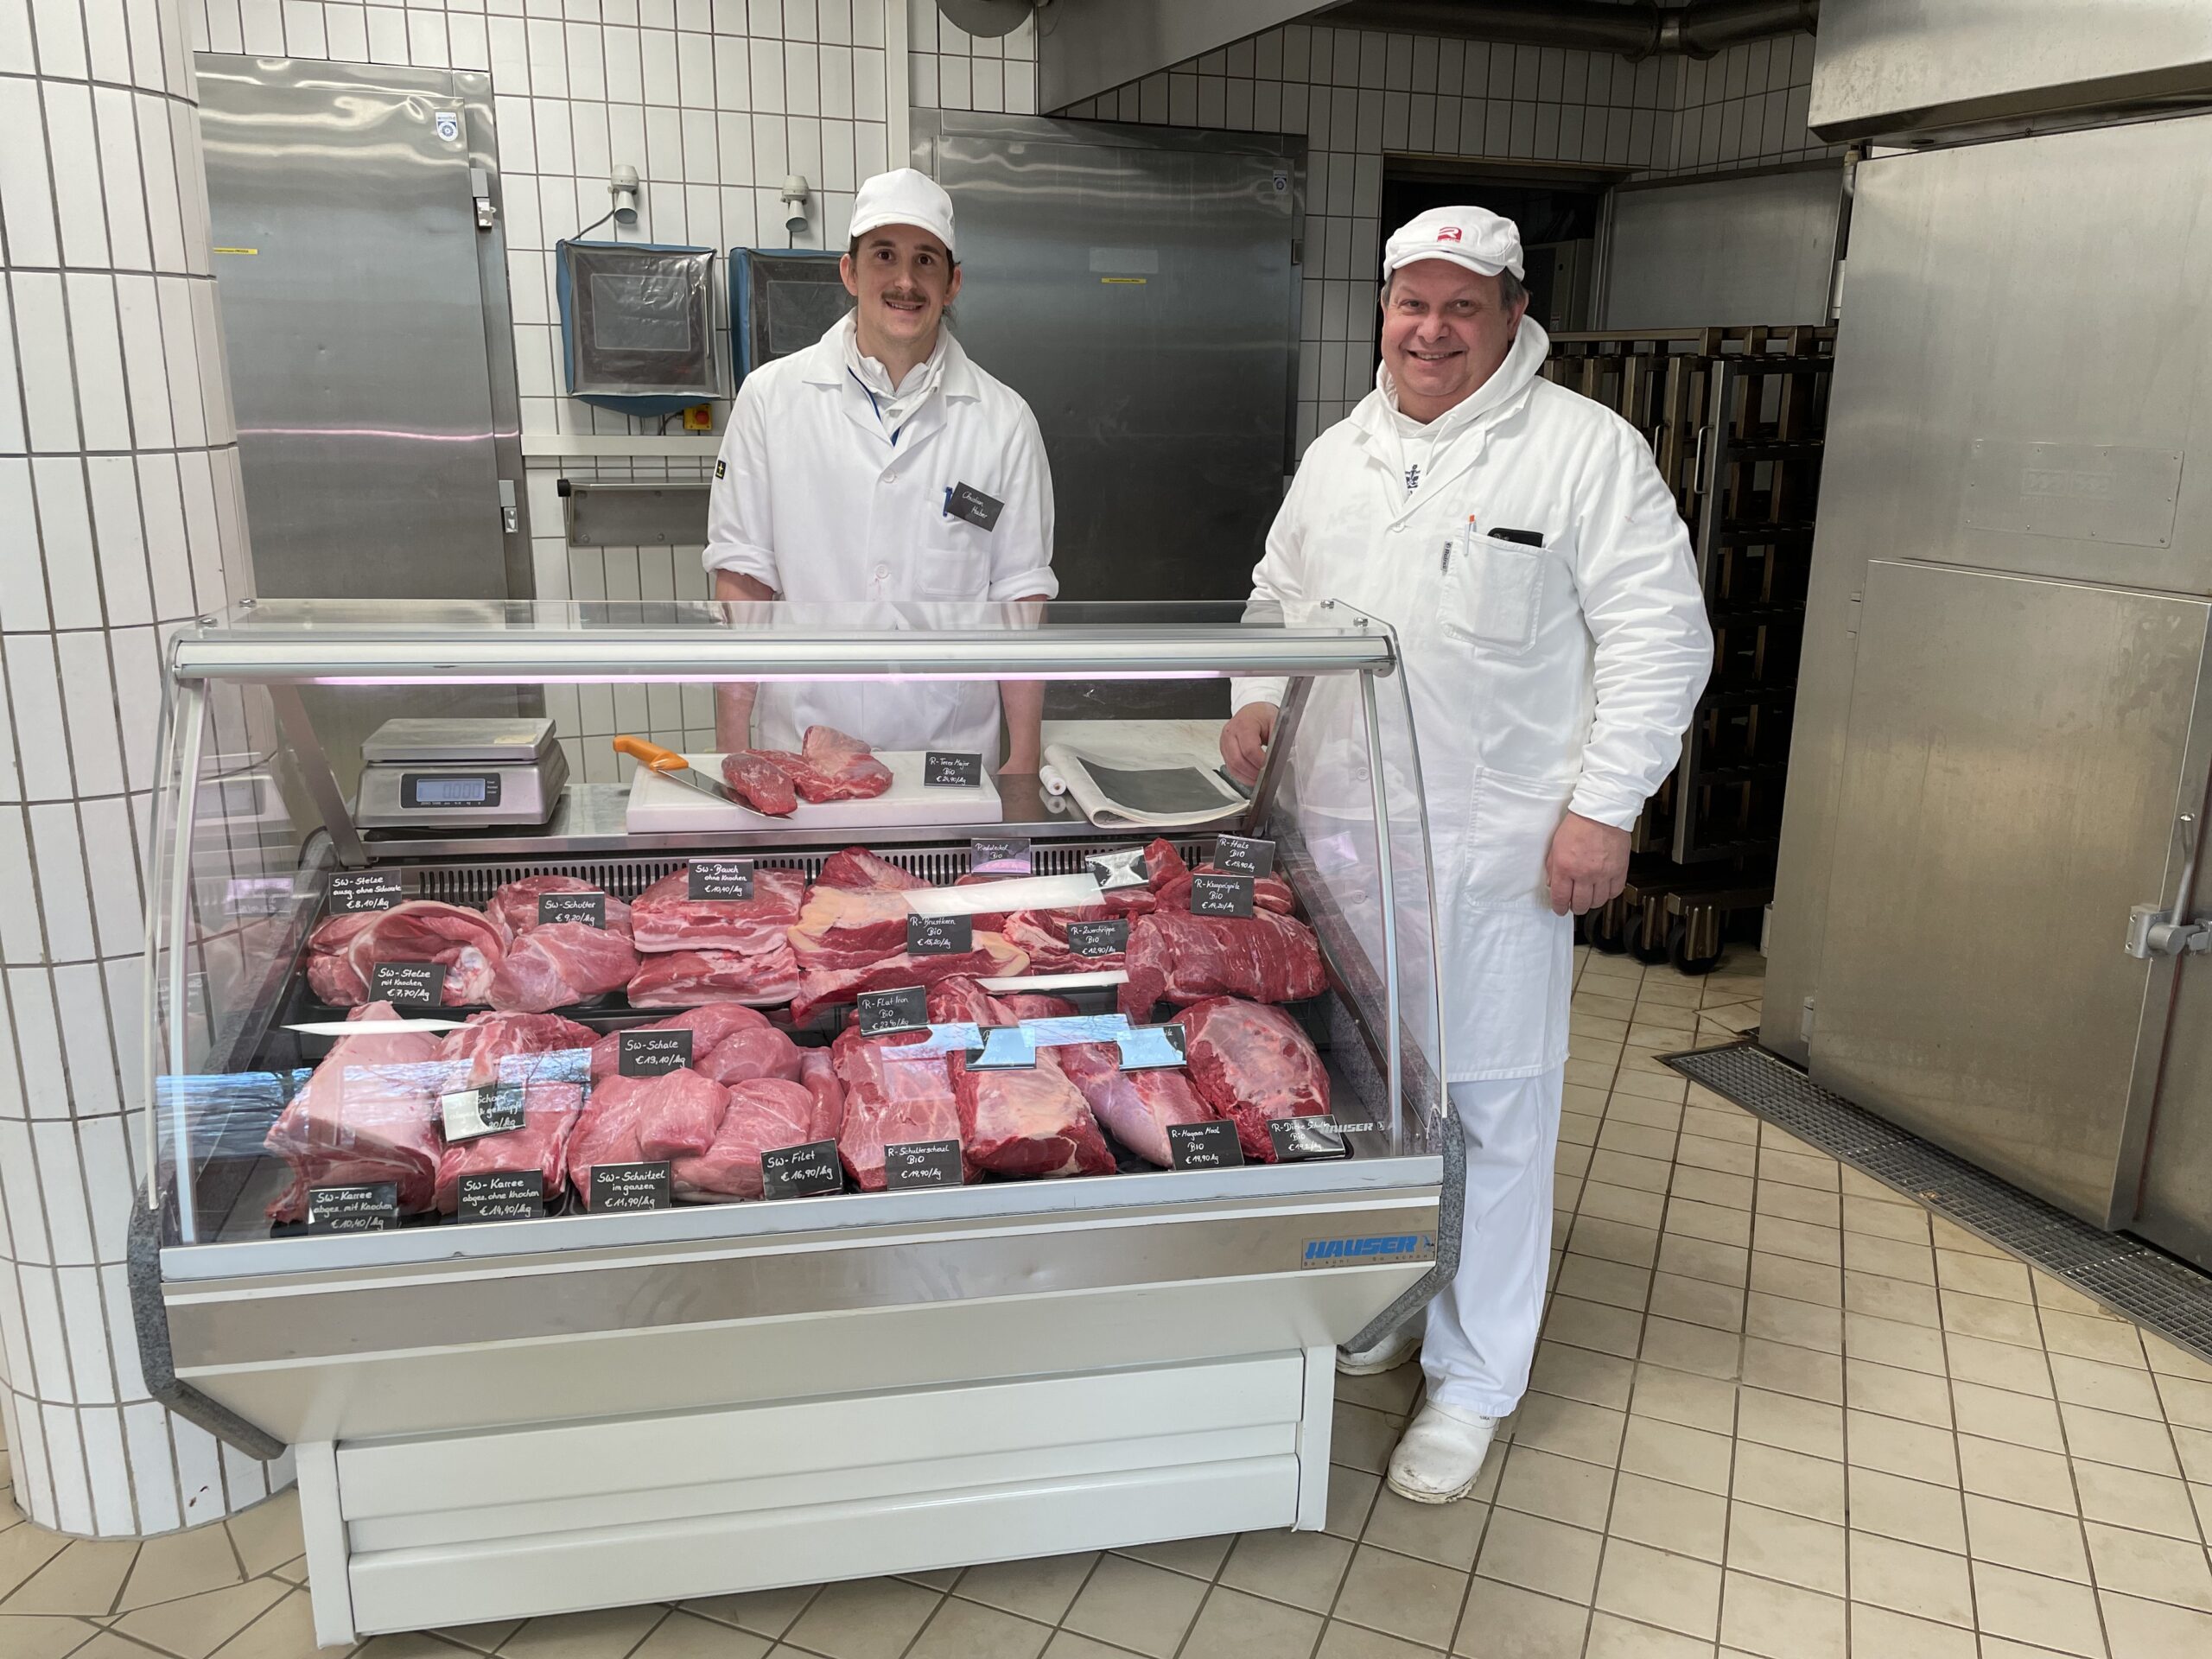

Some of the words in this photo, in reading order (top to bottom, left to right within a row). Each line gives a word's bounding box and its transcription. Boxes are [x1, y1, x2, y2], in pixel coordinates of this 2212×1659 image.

[356, 887, 373, 895] ohne
[487, 1192, 507, 1200] ohne
[508, 1189, 539, 1198] Knochen
[623, 1184, 656, 1196] ganzen
[344, 1202, 359, 1211] mit
[360, 1201, 393, 1211] Knochen
[1305, 1236, 1418, 1260] HAUSER
